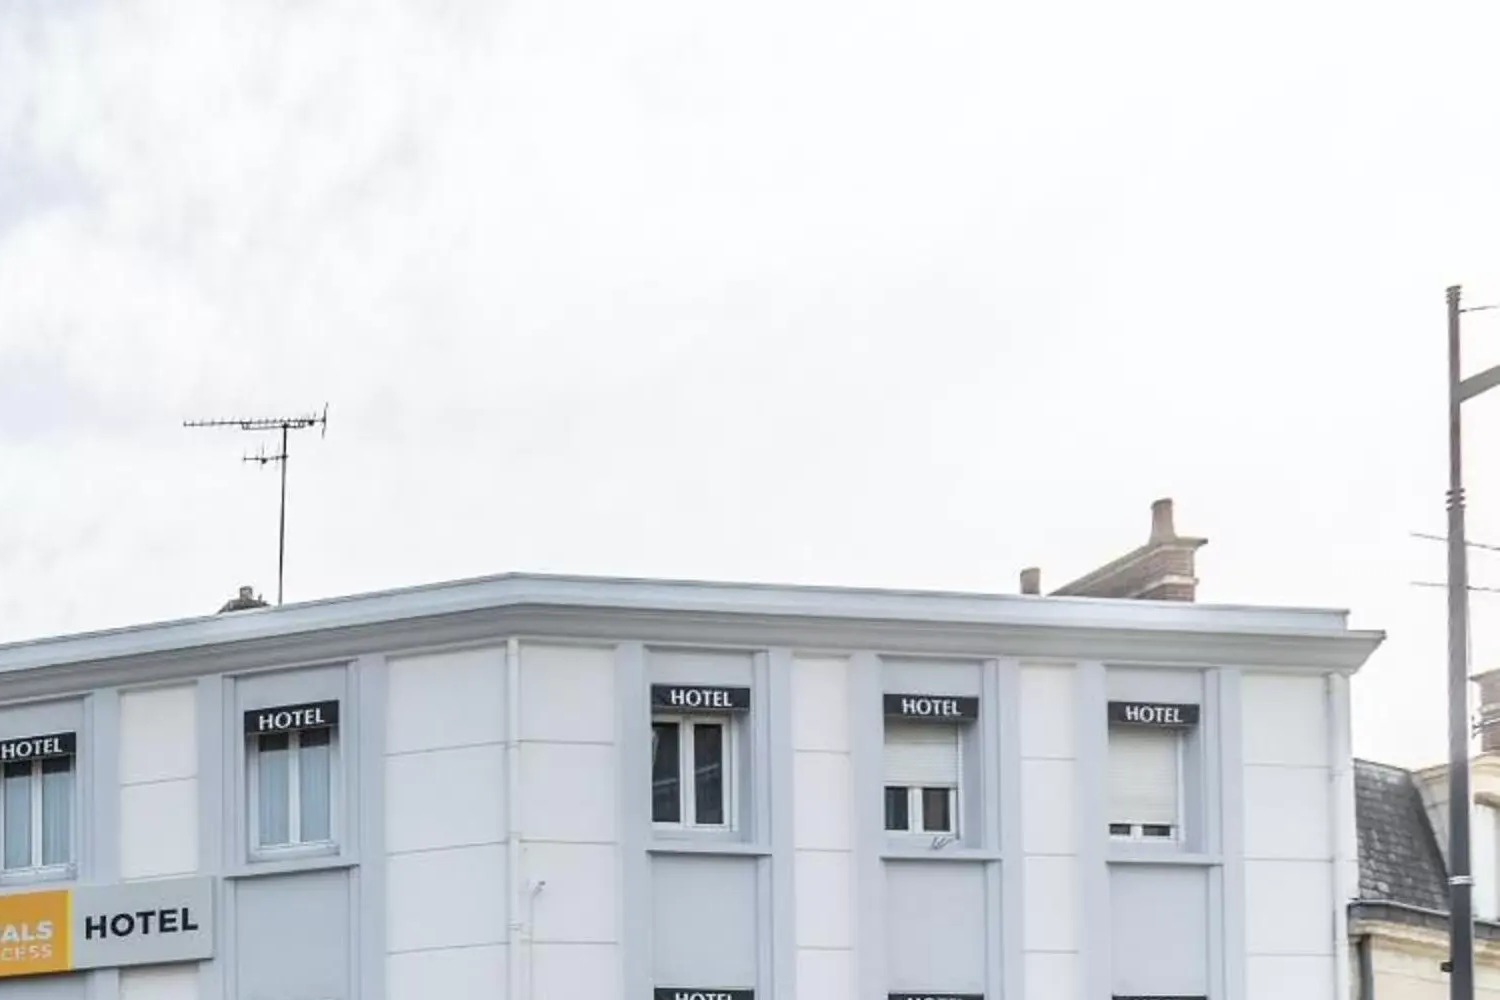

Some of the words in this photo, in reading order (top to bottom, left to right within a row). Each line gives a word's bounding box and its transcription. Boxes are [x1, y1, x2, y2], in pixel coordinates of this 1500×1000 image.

[671, 689, 733, 707] HOTEL
[901, 698, 962, 715] HOTEL
[259, 708, 325, 731] HOTEL
[1125, 706, 1182, 723] HOTEL
[1, 737, 63, 759] HOTEL
[85, 907, 199, 940] HOTEL
